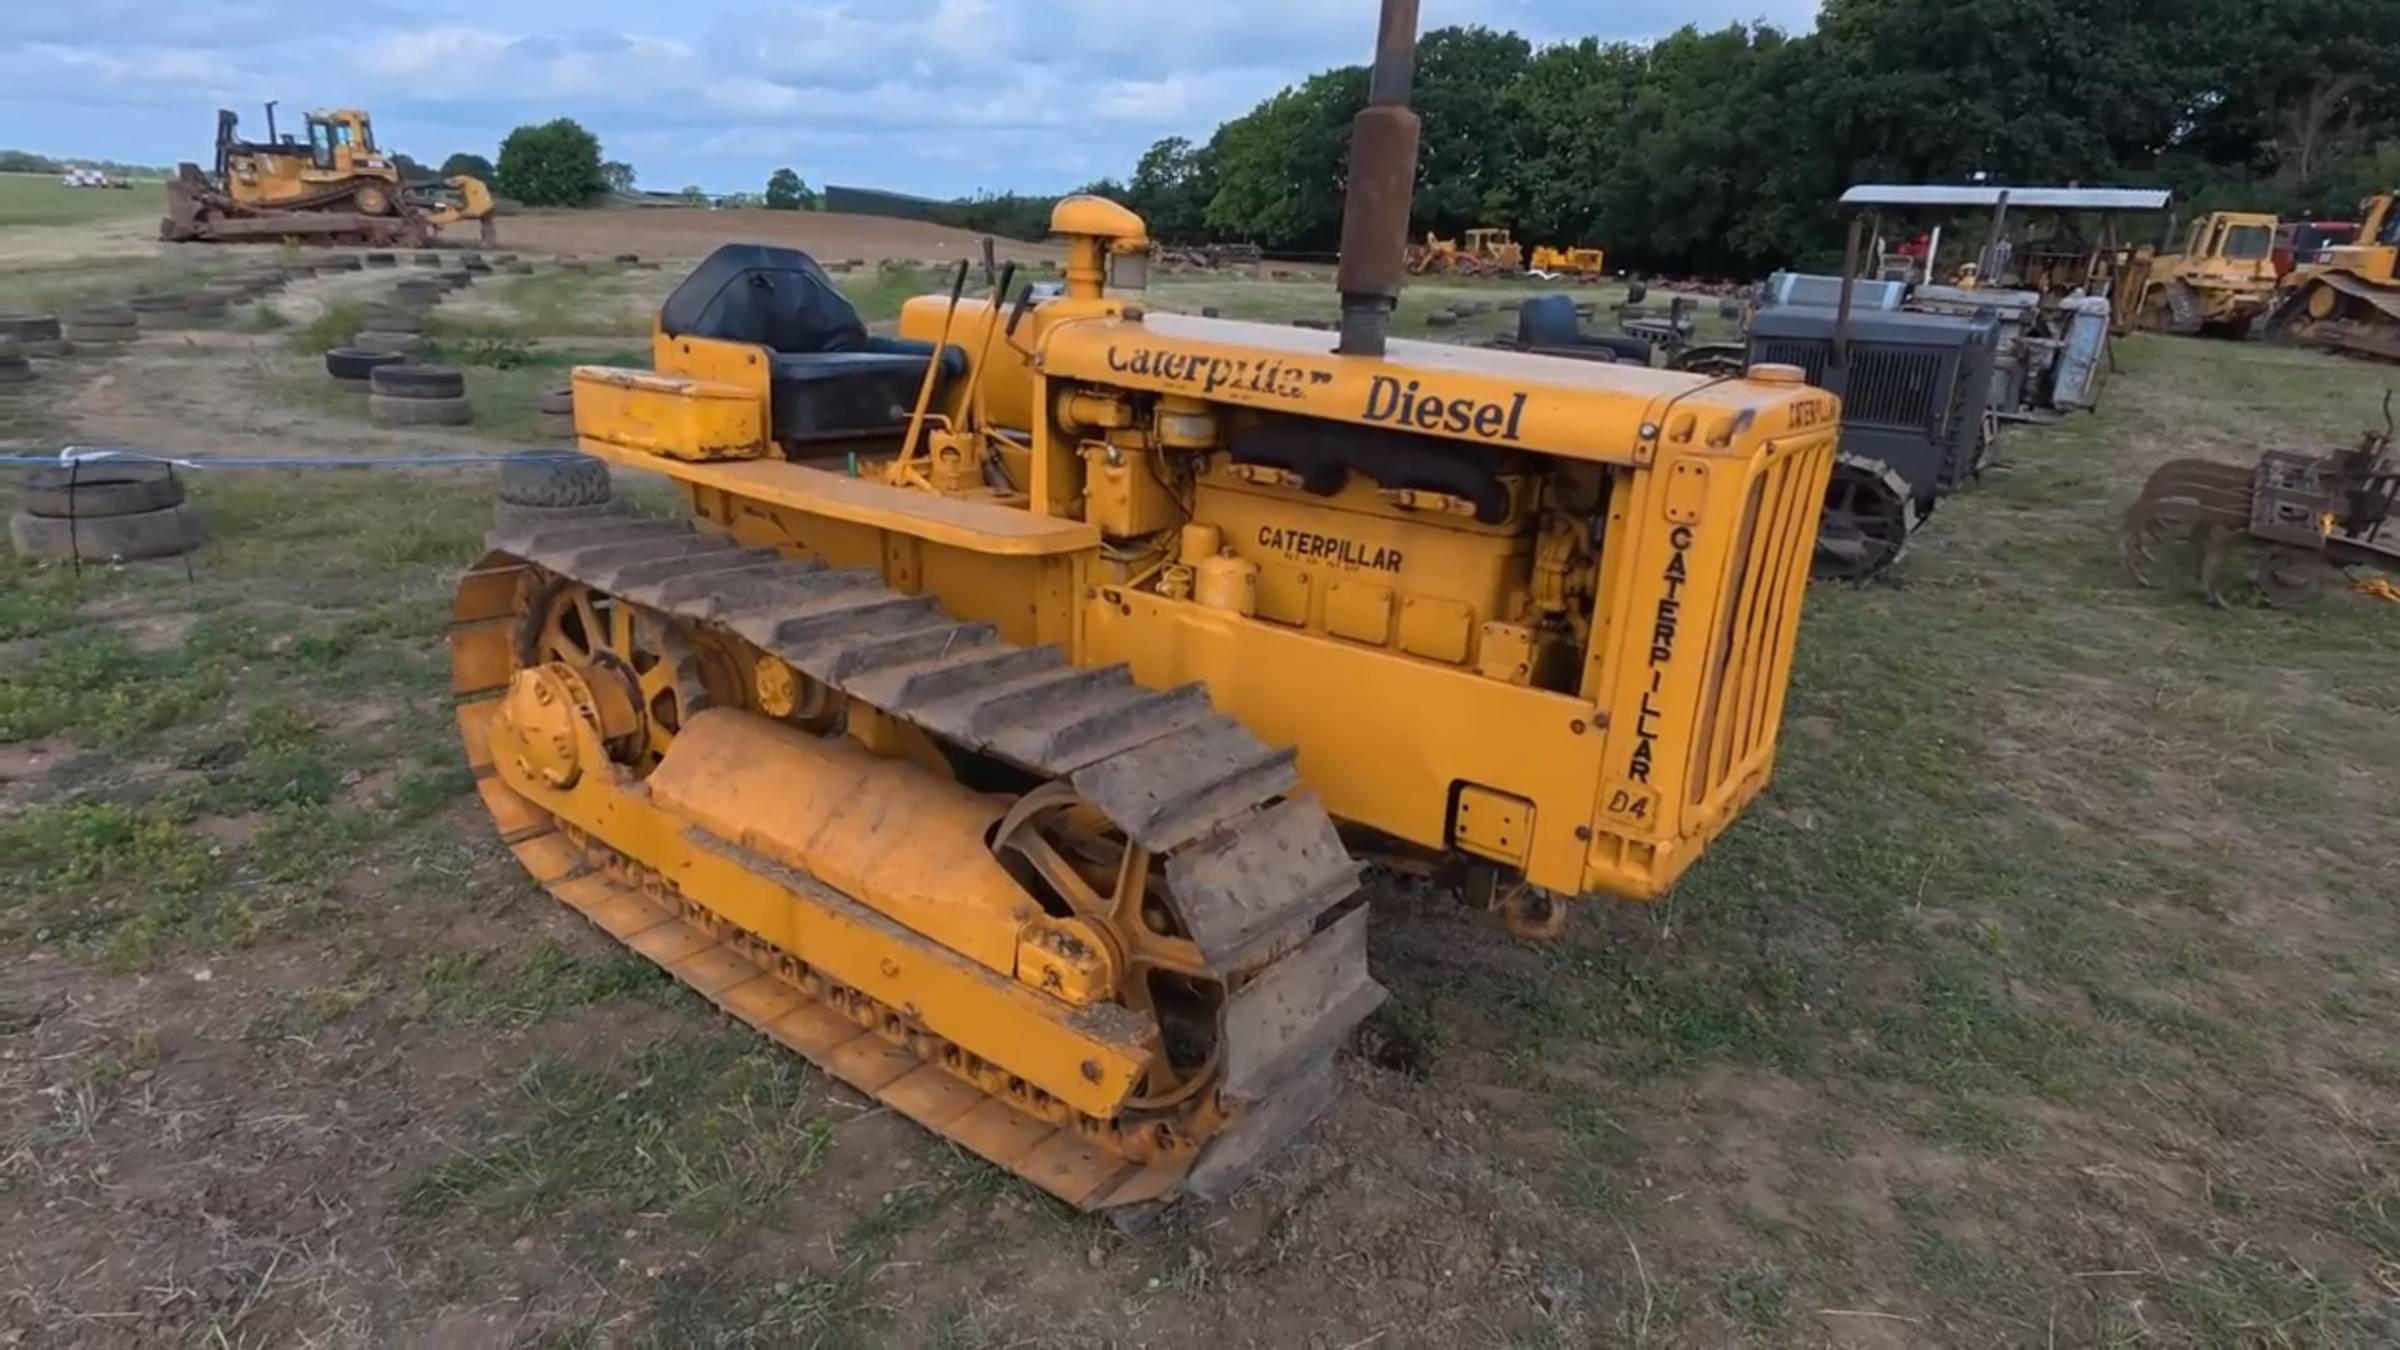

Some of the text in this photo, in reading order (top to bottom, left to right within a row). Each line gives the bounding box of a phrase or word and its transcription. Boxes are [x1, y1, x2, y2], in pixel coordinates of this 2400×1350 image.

[1362, 375, 1527, 440] Diesel
[1258, 526, 1403, 572] CATERPILLAR
[1628, 526, 1692, 784] CATERPILLAR
[1608, 790, 1649, 819] D4
